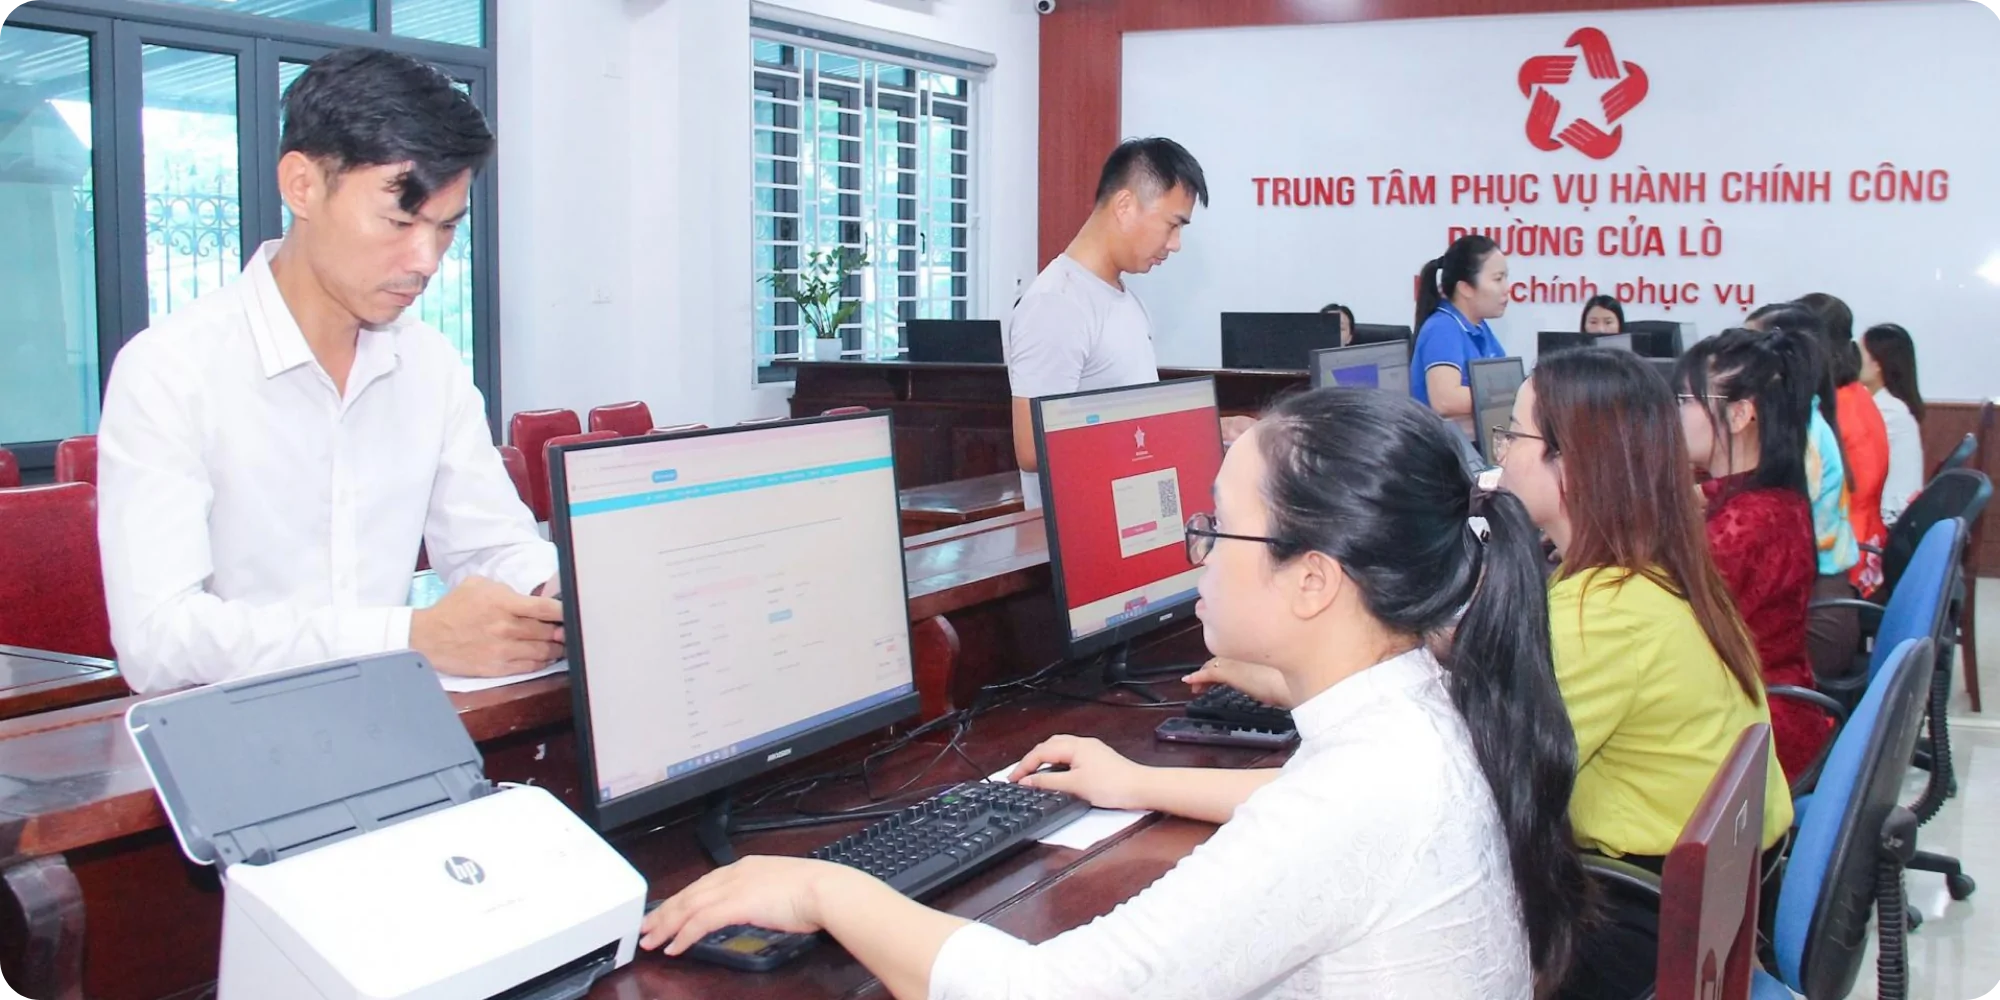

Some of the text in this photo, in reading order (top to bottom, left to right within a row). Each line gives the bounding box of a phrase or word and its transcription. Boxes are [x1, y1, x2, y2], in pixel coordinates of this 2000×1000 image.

[1251, 162, 1949, 213] TRUNG TÂM PHỤC VỤ HÀNH CHÍNH CÔNG
[1597, 214, 1665, 257] CỬA
[1679, 215, 1722, 257] LÒ
[1509, 274, 1756, 311] chính phục vụ
